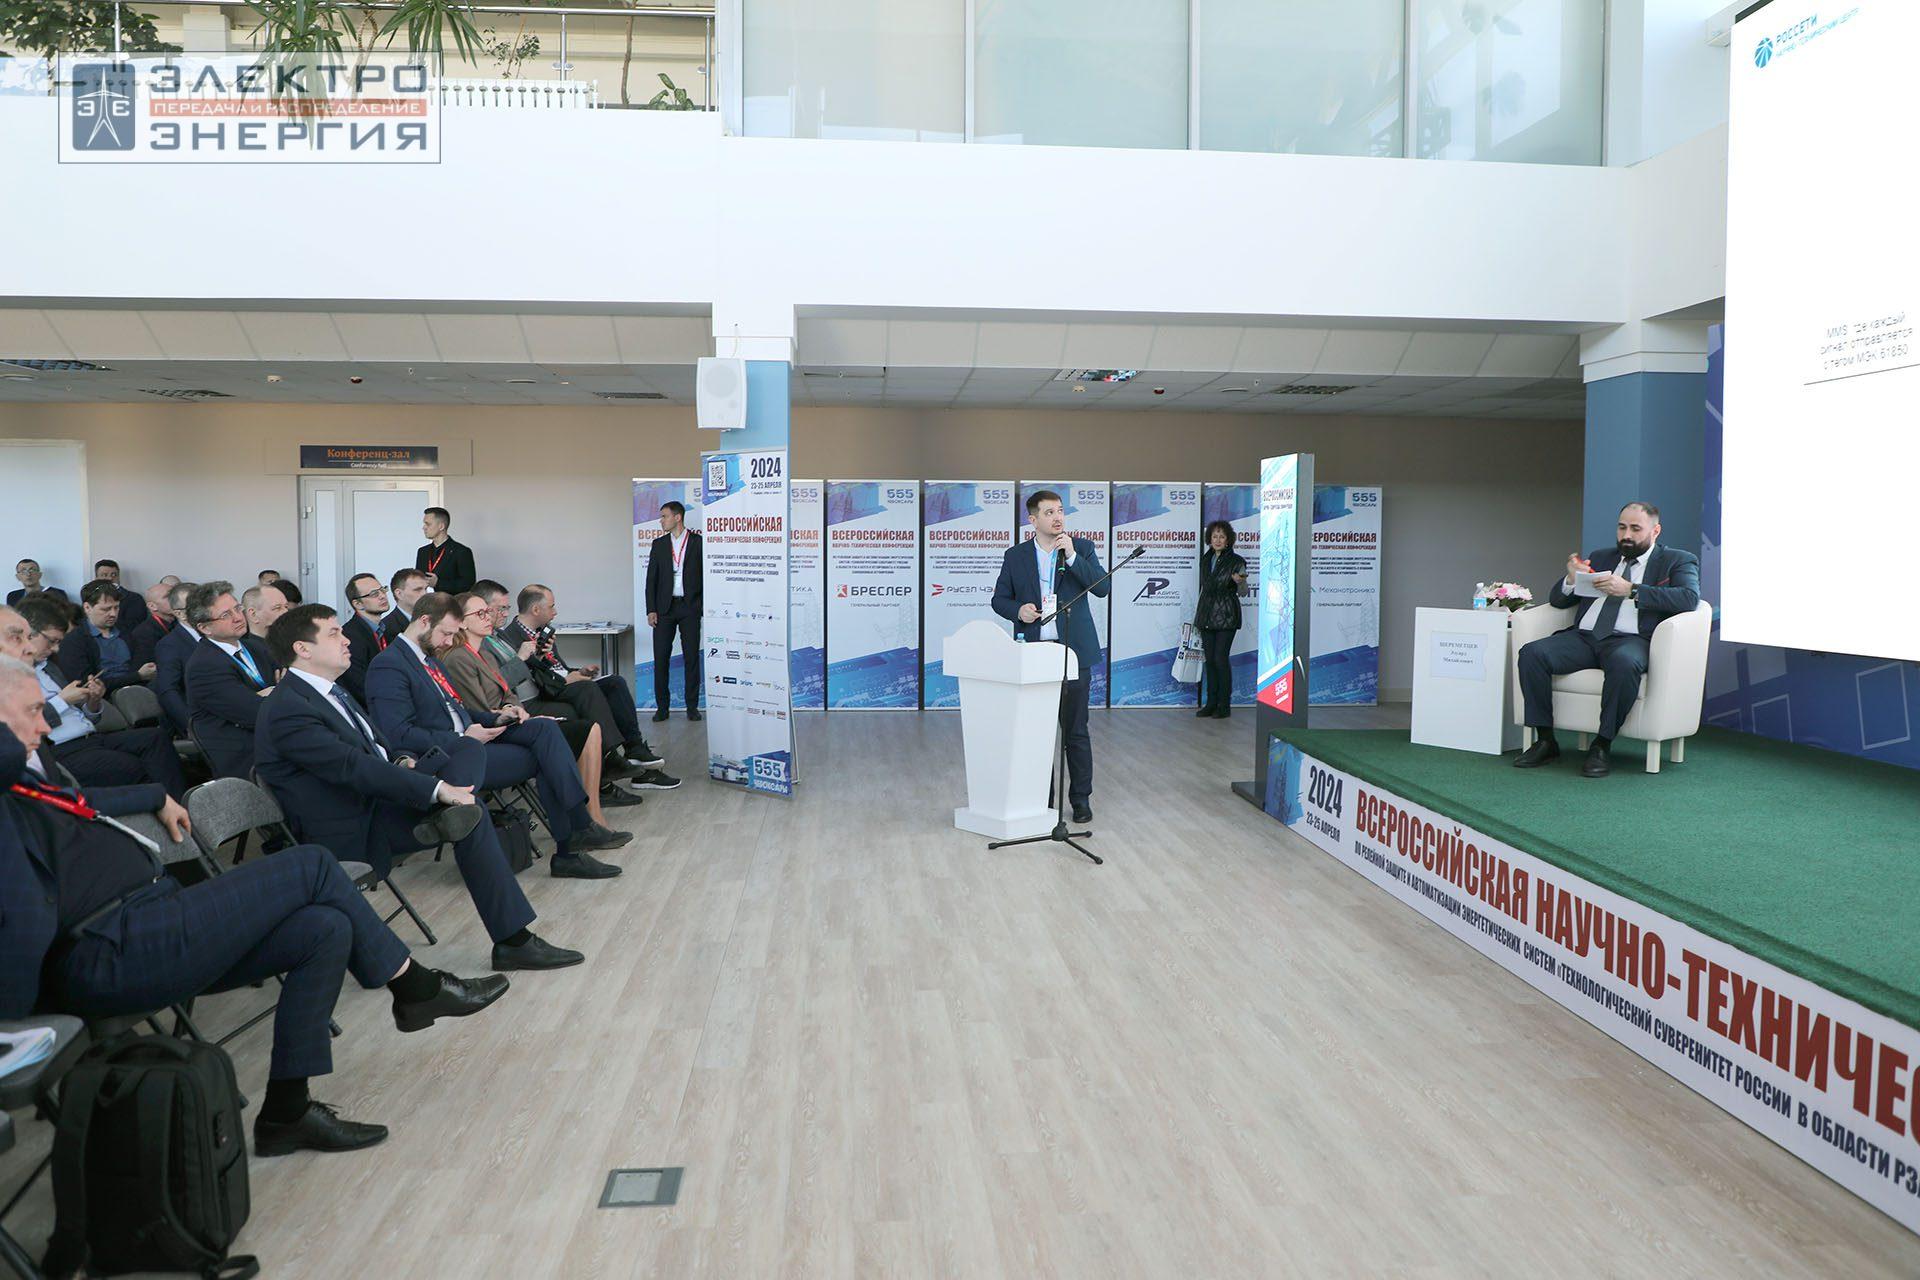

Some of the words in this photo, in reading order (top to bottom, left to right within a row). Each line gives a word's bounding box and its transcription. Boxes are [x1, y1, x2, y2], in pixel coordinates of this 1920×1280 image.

[327, 448, 410, 460] Конференц-зал
[751, 457, 782, 479] 2024
[791, 488, 818, 498] 555
[886, 488, 914, 499] 555
[983, 489, 1010, 500] 555
[1077, 490, 1105, 500] 555
[1169, 490, 1196, 500] 555
[1352, 492, 1377, 503] 555
[706, 514, 783, 533] ВСЕРОССИЙСКАЯ
[832, 528, 915, 541] ВСЕРОССИЙСКАЯ
[929, 529, 1010, 541] ВСЕРОССИЙСКАЯ
[1117, 530, 1196, 541] ВСЕРОССИЙСКАЯ
[1312, 530, 1377, 543] ЕРОССИЙСКАЯ
[851, 586, 912, 597] БРЕСЛЕР
[755, 759, 782, 779] 555
[1308, 765, 1344, 819] 2024
[1321, 820, 1340, 843] АПРЕЛЯ
[1356, 788, 1529, 926] ВСЕРОССИЙСКАЯ
[1354, 840, 1361, 854] ПО
[1362, 844, 1386, 872] РЕЛЕЙНОЙ
[1386, 859, 1407, 883] ЗАЩИТЕ
[1407, 873, 1412, 887] И
[1412, 874, 1461, 917] АВТОМАТИЗАЦИИ
[1462, 904, 1521, 954] ЭНЕРГЕТИЧЕСКИХ
[1524, 940, 1556, 976] СИСТЕМ
[1654, 1017, 1733, 1083] СУВЕРЕНИТЕТ
[1735, 1065, 1791, 1118] РОССИИ
[1798, 1101, 1808, 1128] В
[1811, 1110, 1889, 1178] ОБЛАСТИ
